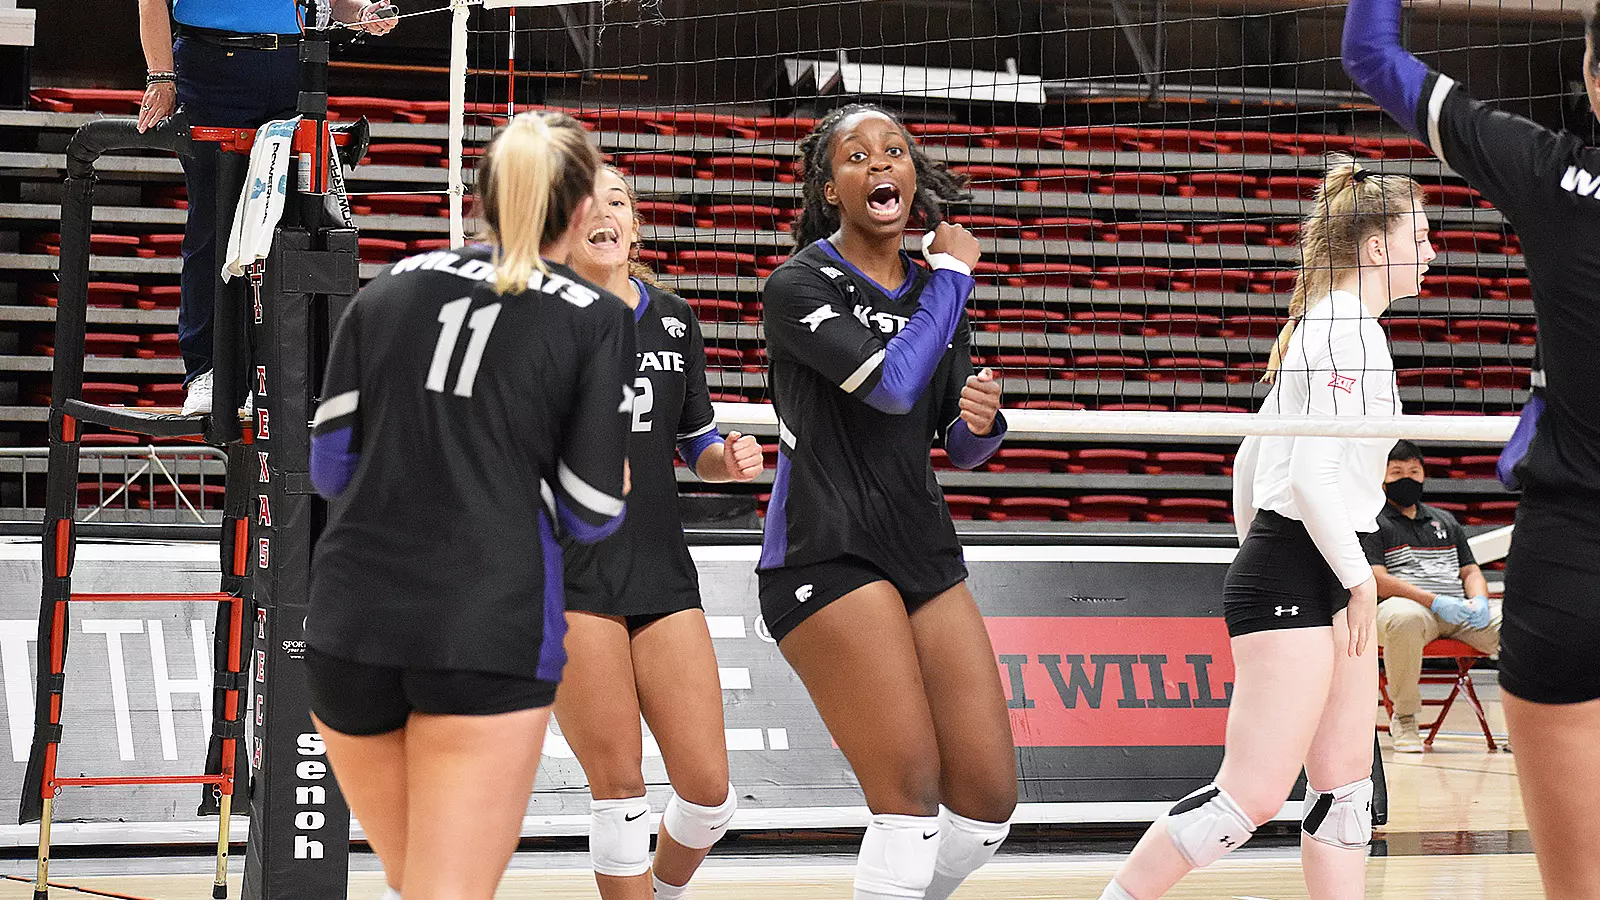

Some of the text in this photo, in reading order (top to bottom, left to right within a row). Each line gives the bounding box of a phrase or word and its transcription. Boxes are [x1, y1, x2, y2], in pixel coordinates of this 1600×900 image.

[425, 297, 502, 397] 11
[998, 654, 1234, 709] I WILL
[294, 732, 327, 859] Senoh
